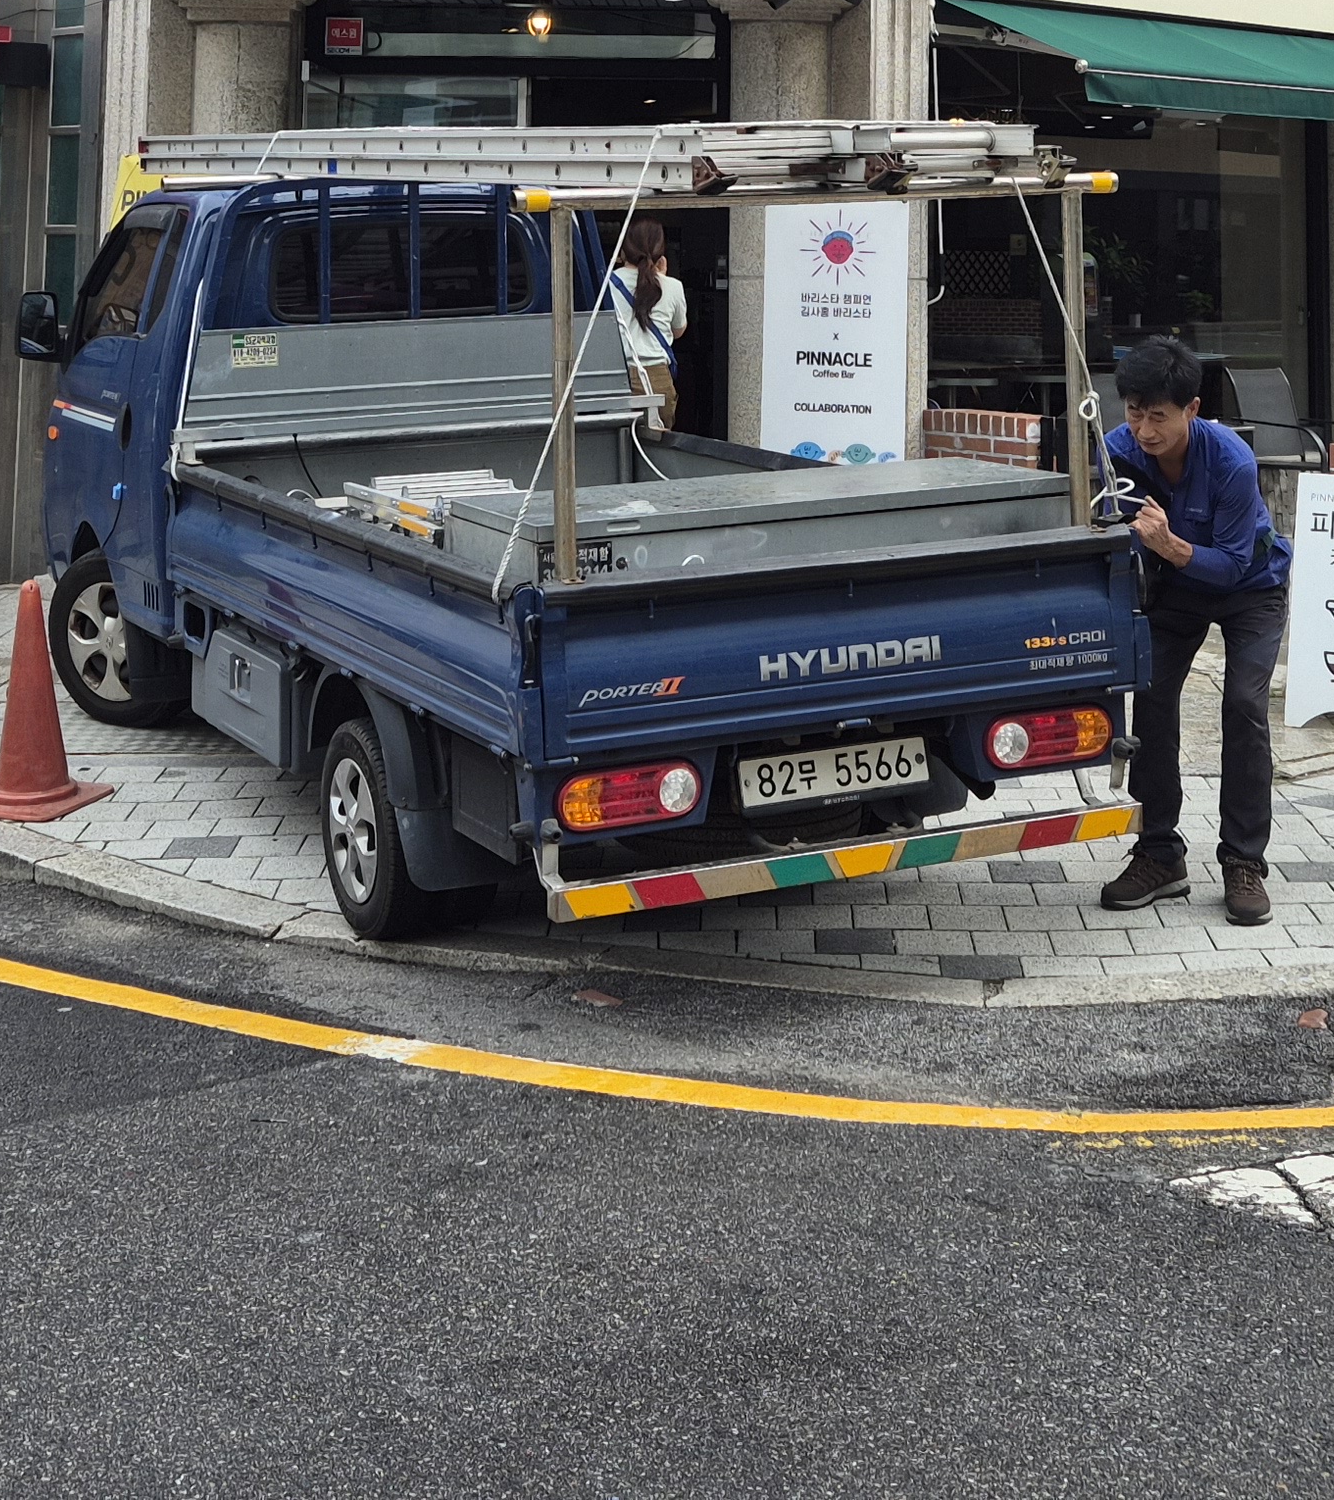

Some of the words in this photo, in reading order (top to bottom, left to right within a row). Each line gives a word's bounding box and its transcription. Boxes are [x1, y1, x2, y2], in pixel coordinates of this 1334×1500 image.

[800, 292, 839, 304] 바리스타
[843, 293, 872, 306] 챔피언
[833, 306, 872, 319] 바리스타
[796, 350, 873, 368] PINNACLE
[812, 369, 839, 378] Coffee
[841, 370, 855, 379] Bar
[794, 402, 872, 415] COLLABORATION
[759, 635, 942, 682] HYUNDAI
[1077, 652, 1108, 665] 1000kg
[758, 759, 816, 798] 82무
[834, 744, 913, 788] 5566
